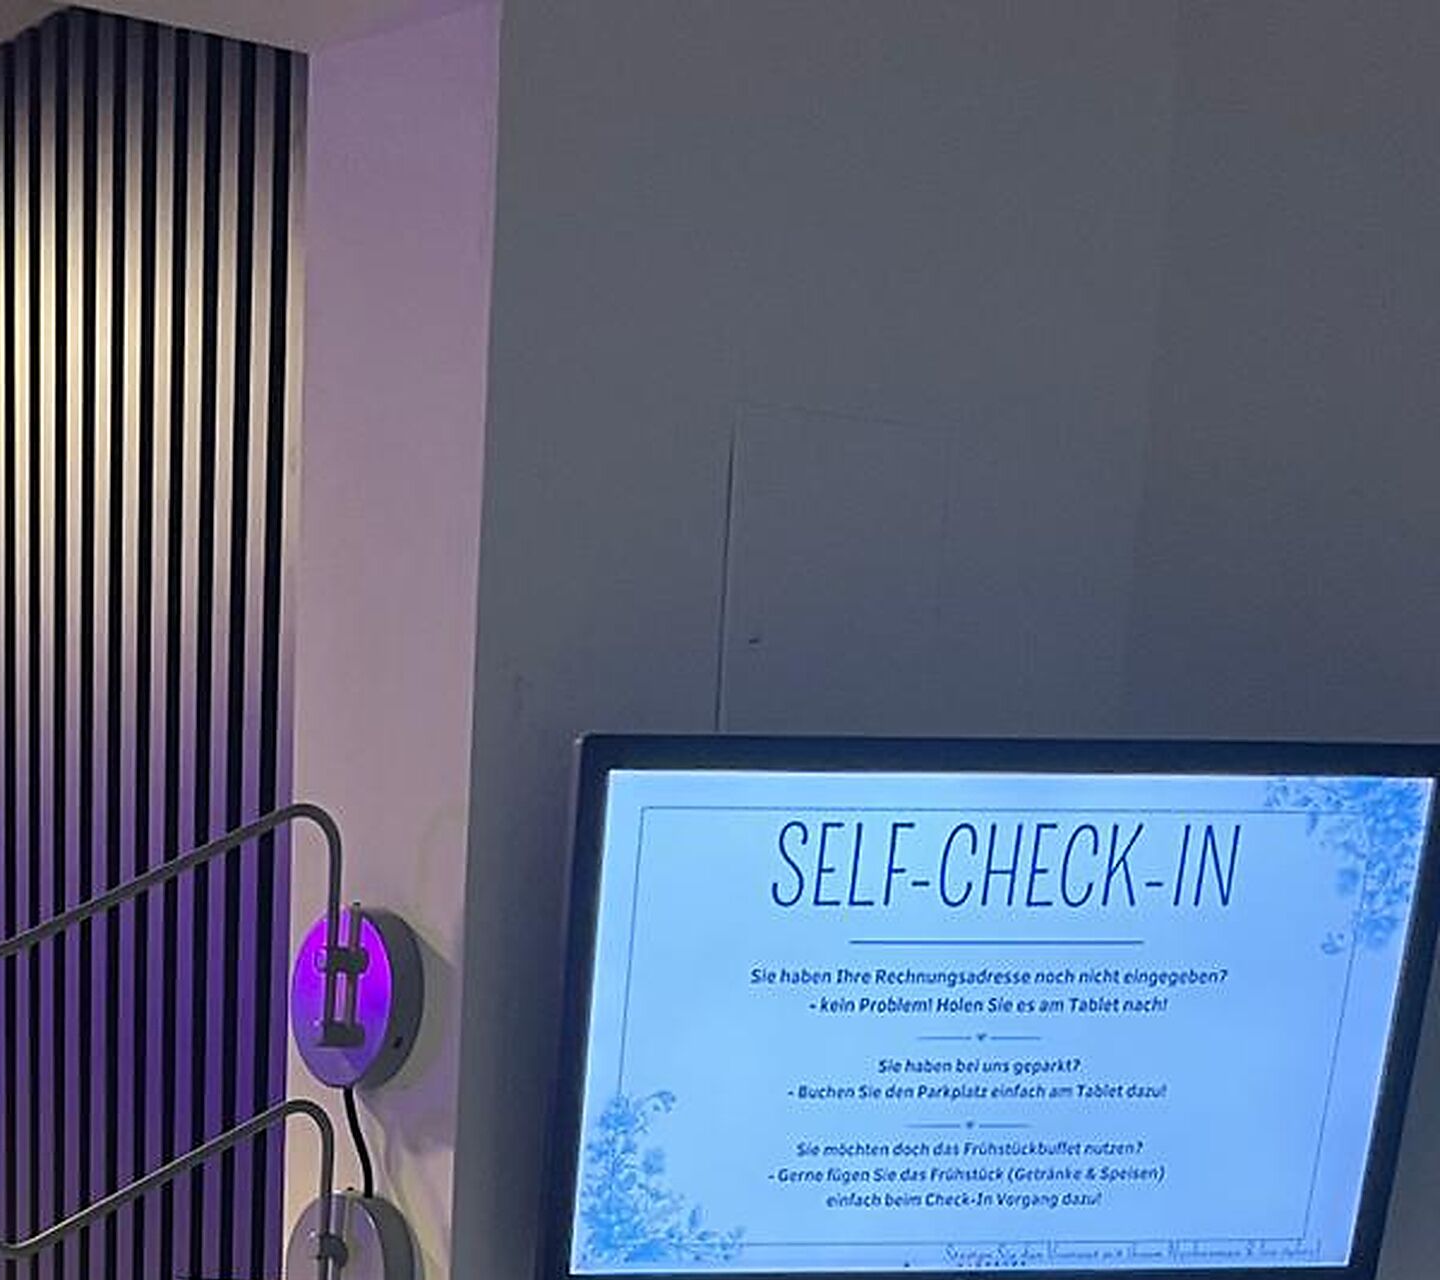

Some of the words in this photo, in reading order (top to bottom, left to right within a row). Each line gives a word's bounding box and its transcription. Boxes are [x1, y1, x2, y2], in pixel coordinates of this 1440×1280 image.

[771, 820, 1241, 907] SELF-CHECK-IN
[750, 968, 777, 985] Sie
[779, 968, 831, 985] haben
[836, 968, 872, 985] Ihre
[875, 968, 1031, 988] Rechnungsadresse
[1034, 968, 1075, 984] noch
[1078, 968, 1120, 984] nicht
[1123, 968, 1229, 988] eingegeben?
[820, 997, 855, 1013] kein
[859, 997, 933, 1013] Problem!
[936, 997, 984, 1013] Holen
[987, 997, 1013, 1013] Sie
[1016, 1000, 1035, 1013] es
[1038, 1000, 1065, 1013] am
[1068, 997, 1120, 1013] Tablet
[1122, 997, 1168, 1013] nach!
[877, 1058, 903, 1074] Sie
[904, 1058, 953, 1074] haben
[955, 1058, 980, 1073] bei
[982, 1060, 1010, 1073] uns
[1013, 1058, 1081, 1076] geparkt?
[797, 1084, 856, 1099] Buchen
[858, 1084, 882, 1099] Sie
[885, 1084, 914, 1099] den
[917, 1084, 988, 1101] Parkplatz
[990, 1083, 1046, 1099] einfach
[1048, 1086, 1073, 1098] am
[1076, 1084, 1124, 1098] Tablet
[1126, 1083, 1167, 1098] dazu!
[796, 1141, 821, 1157] Sie
[822, 1142, 890, 1157] möchten
[892, 1142, 930, 1157] doch
[933, 1142, 960, 1156] das
[1083, 1140, 1144, 1155] nutzen?
[777, 1168, 824, 1183] Gerne
[826, 1167, 871, 1184] fügen
[873, 1168, 898, 1183] Sie
[899, 1168, 927, 1183] das
[930, 1167, 1004, 1183] Frühstück
[1007, 1166, 1083, 1183] (Getränke
[1099, 1165, 1166, 1184] Speisen)
[825, 1192, 882, 1208] einfach
[884, 1192, 922, 1208] beim
[924, 1191, 993, 1208] Check-In
[996, 1191, 1060, 1209] Vorgang
[1061, 1191, 1103, 1207] dazu!
